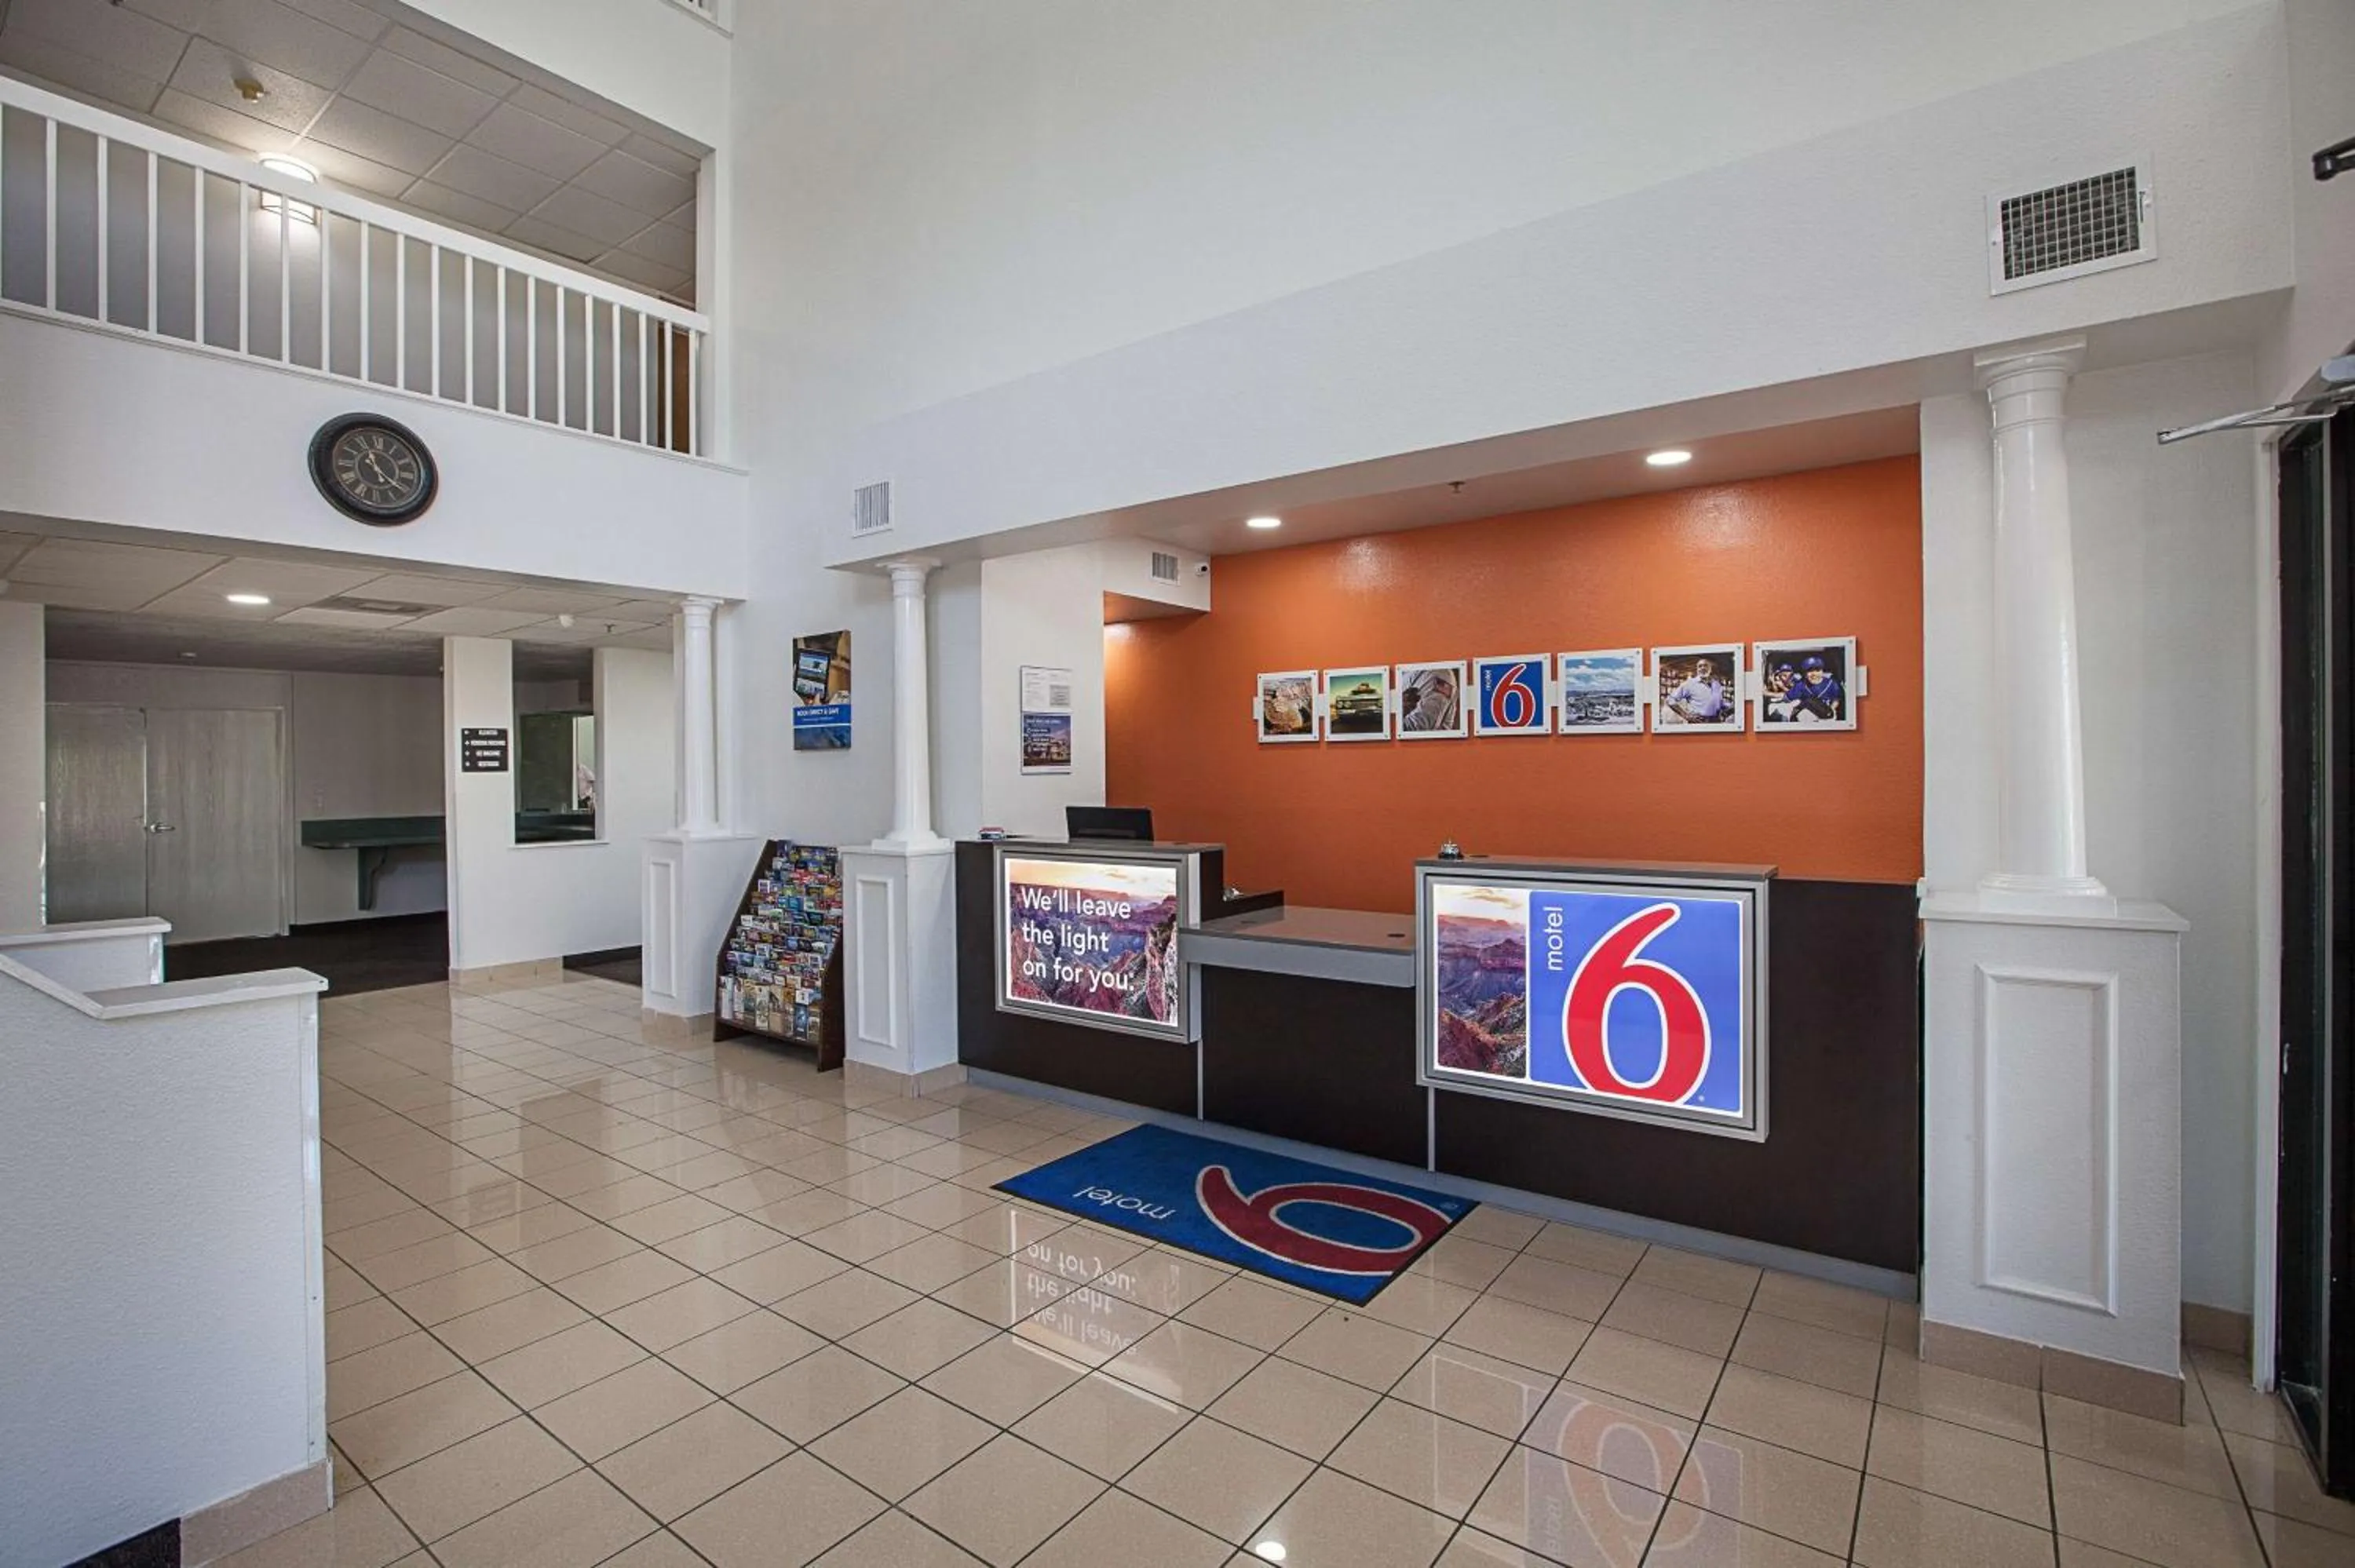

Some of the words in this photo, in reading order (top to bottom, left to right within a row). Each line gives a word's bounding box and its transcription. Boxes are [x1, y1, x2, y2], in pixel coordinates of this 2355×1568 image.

[1491, 663, 1535, 728] 6
[1022, 886, 1068, 913] We'll
[1076, 889, 1131, 919] leave
[1022, 920, 1053, 945] the
[1061, 924, 1109, 955] light
[1543, 906, 1563, 971] motel
[1023, 961, 1046, 979] on
[1053, 957, 1084, 983] for
[1562, 903, 1711, 1105] 6
[1072, 1186, 1177, 1220] motel
[1196, 1165, 1452, 1276] 6
